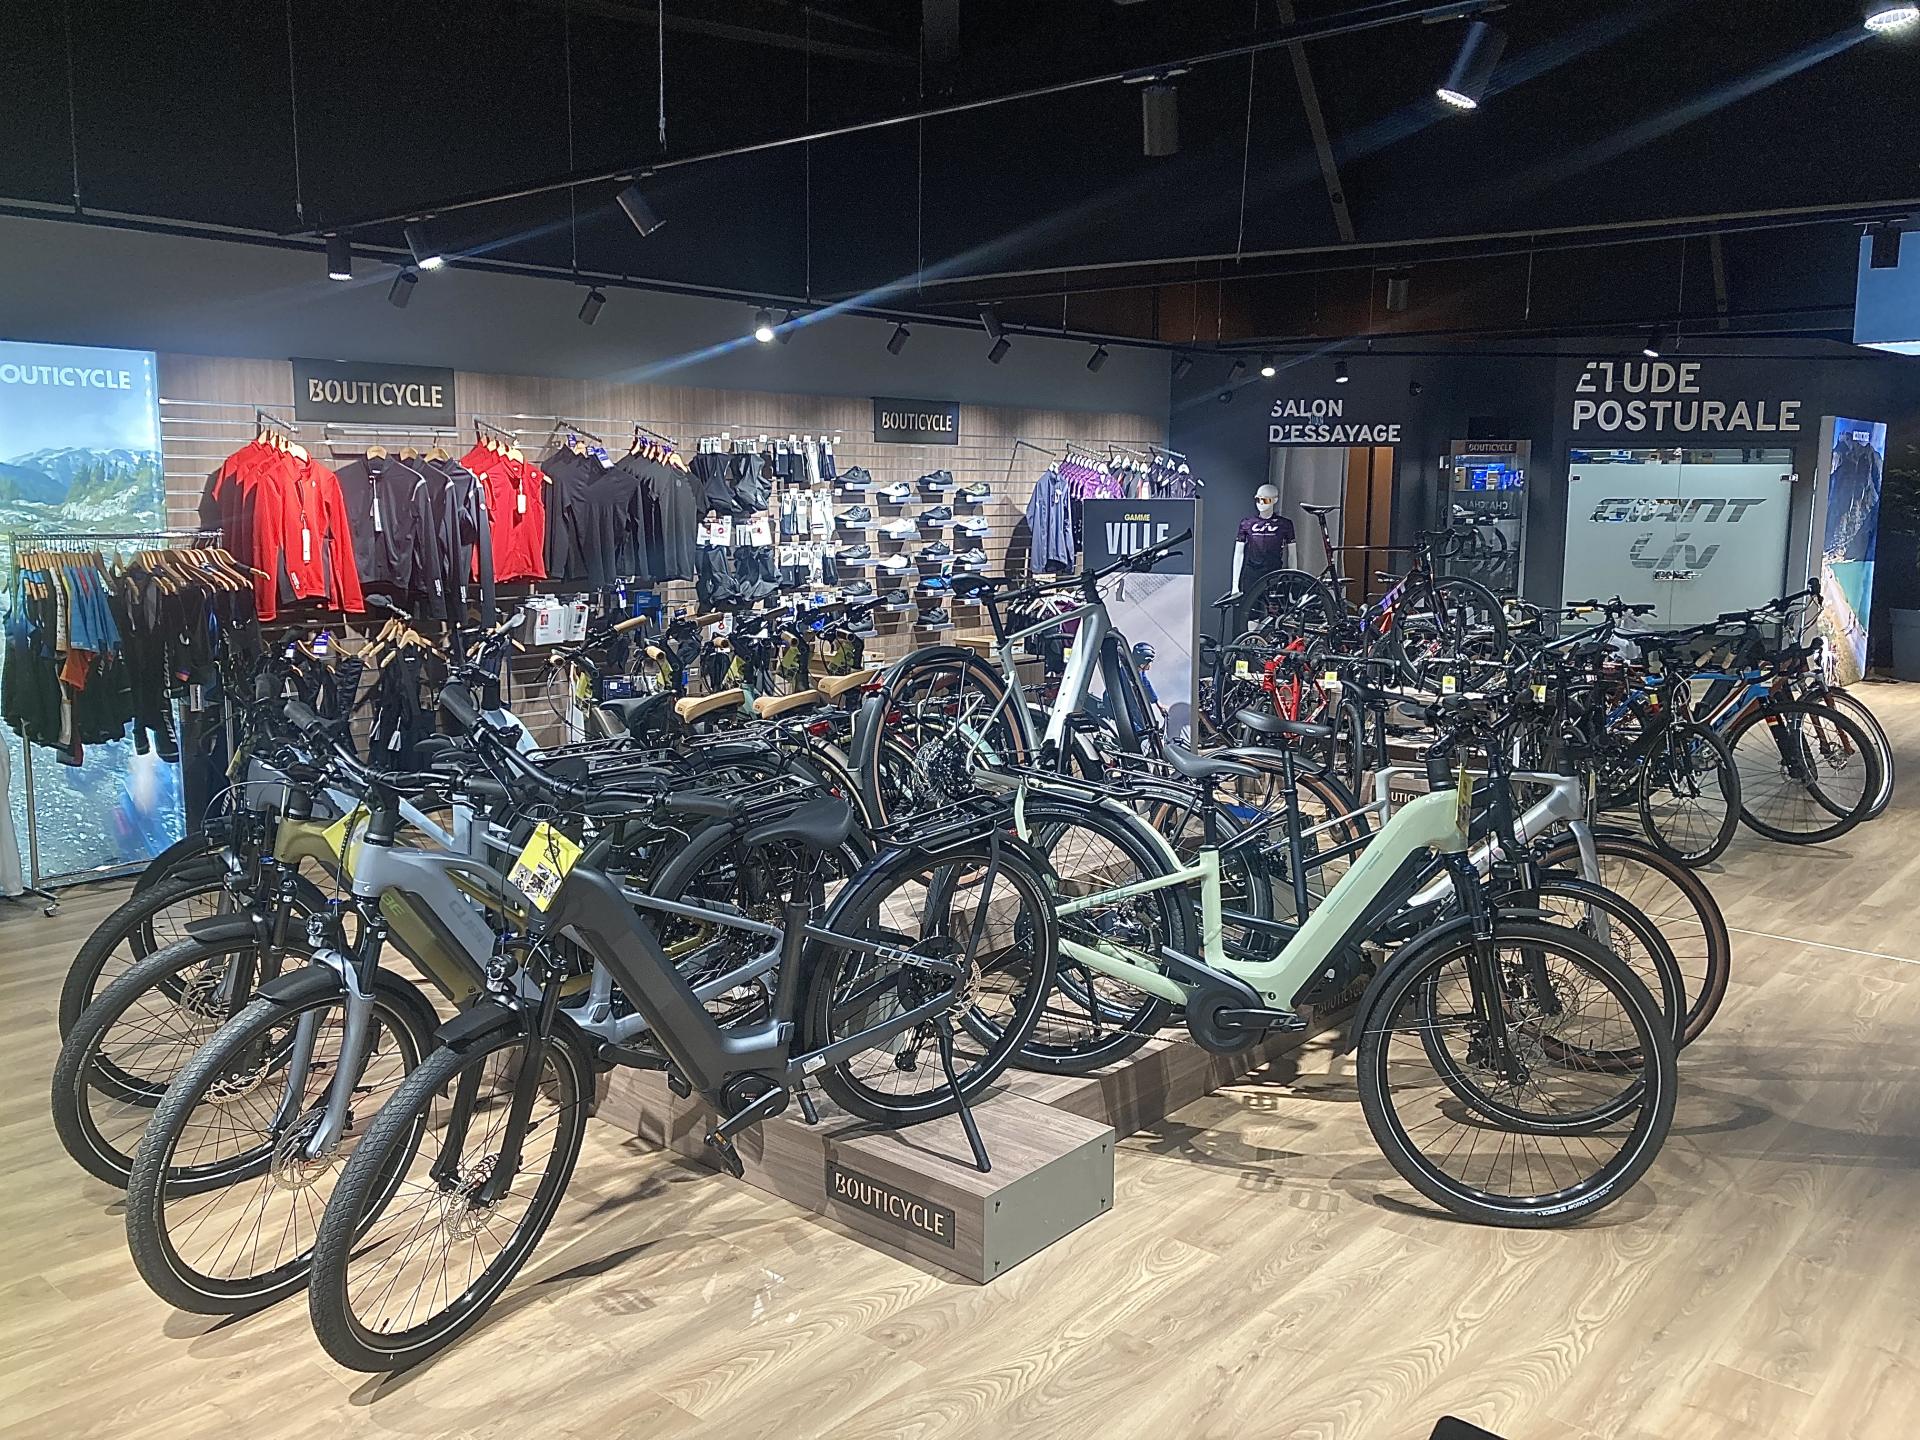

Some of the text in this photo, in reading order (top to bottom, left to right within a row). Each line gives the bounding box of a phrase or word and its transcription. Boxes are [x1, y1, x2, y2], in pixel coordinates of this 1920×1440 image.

[0, 364, 131, 390] OUTICYCLE
[308, 378, 443, 408] BOUTICYCLE
[1271, 400, 1343, 417] SALON
[1572, 400, 1801, 432] POSTURALE
[882, 412, 952, 431] BOUTICYCLE
[1269, 424, 1401, 443] D'ESSAYAGE
[1468, 443, 1514, 452] BOUTICYCLE
[1589, 498, 1768, 523] GIANT
[875, 946, 933, 970] CUBE
[835, 1172, 944, 1236] BOUTICYCLE
